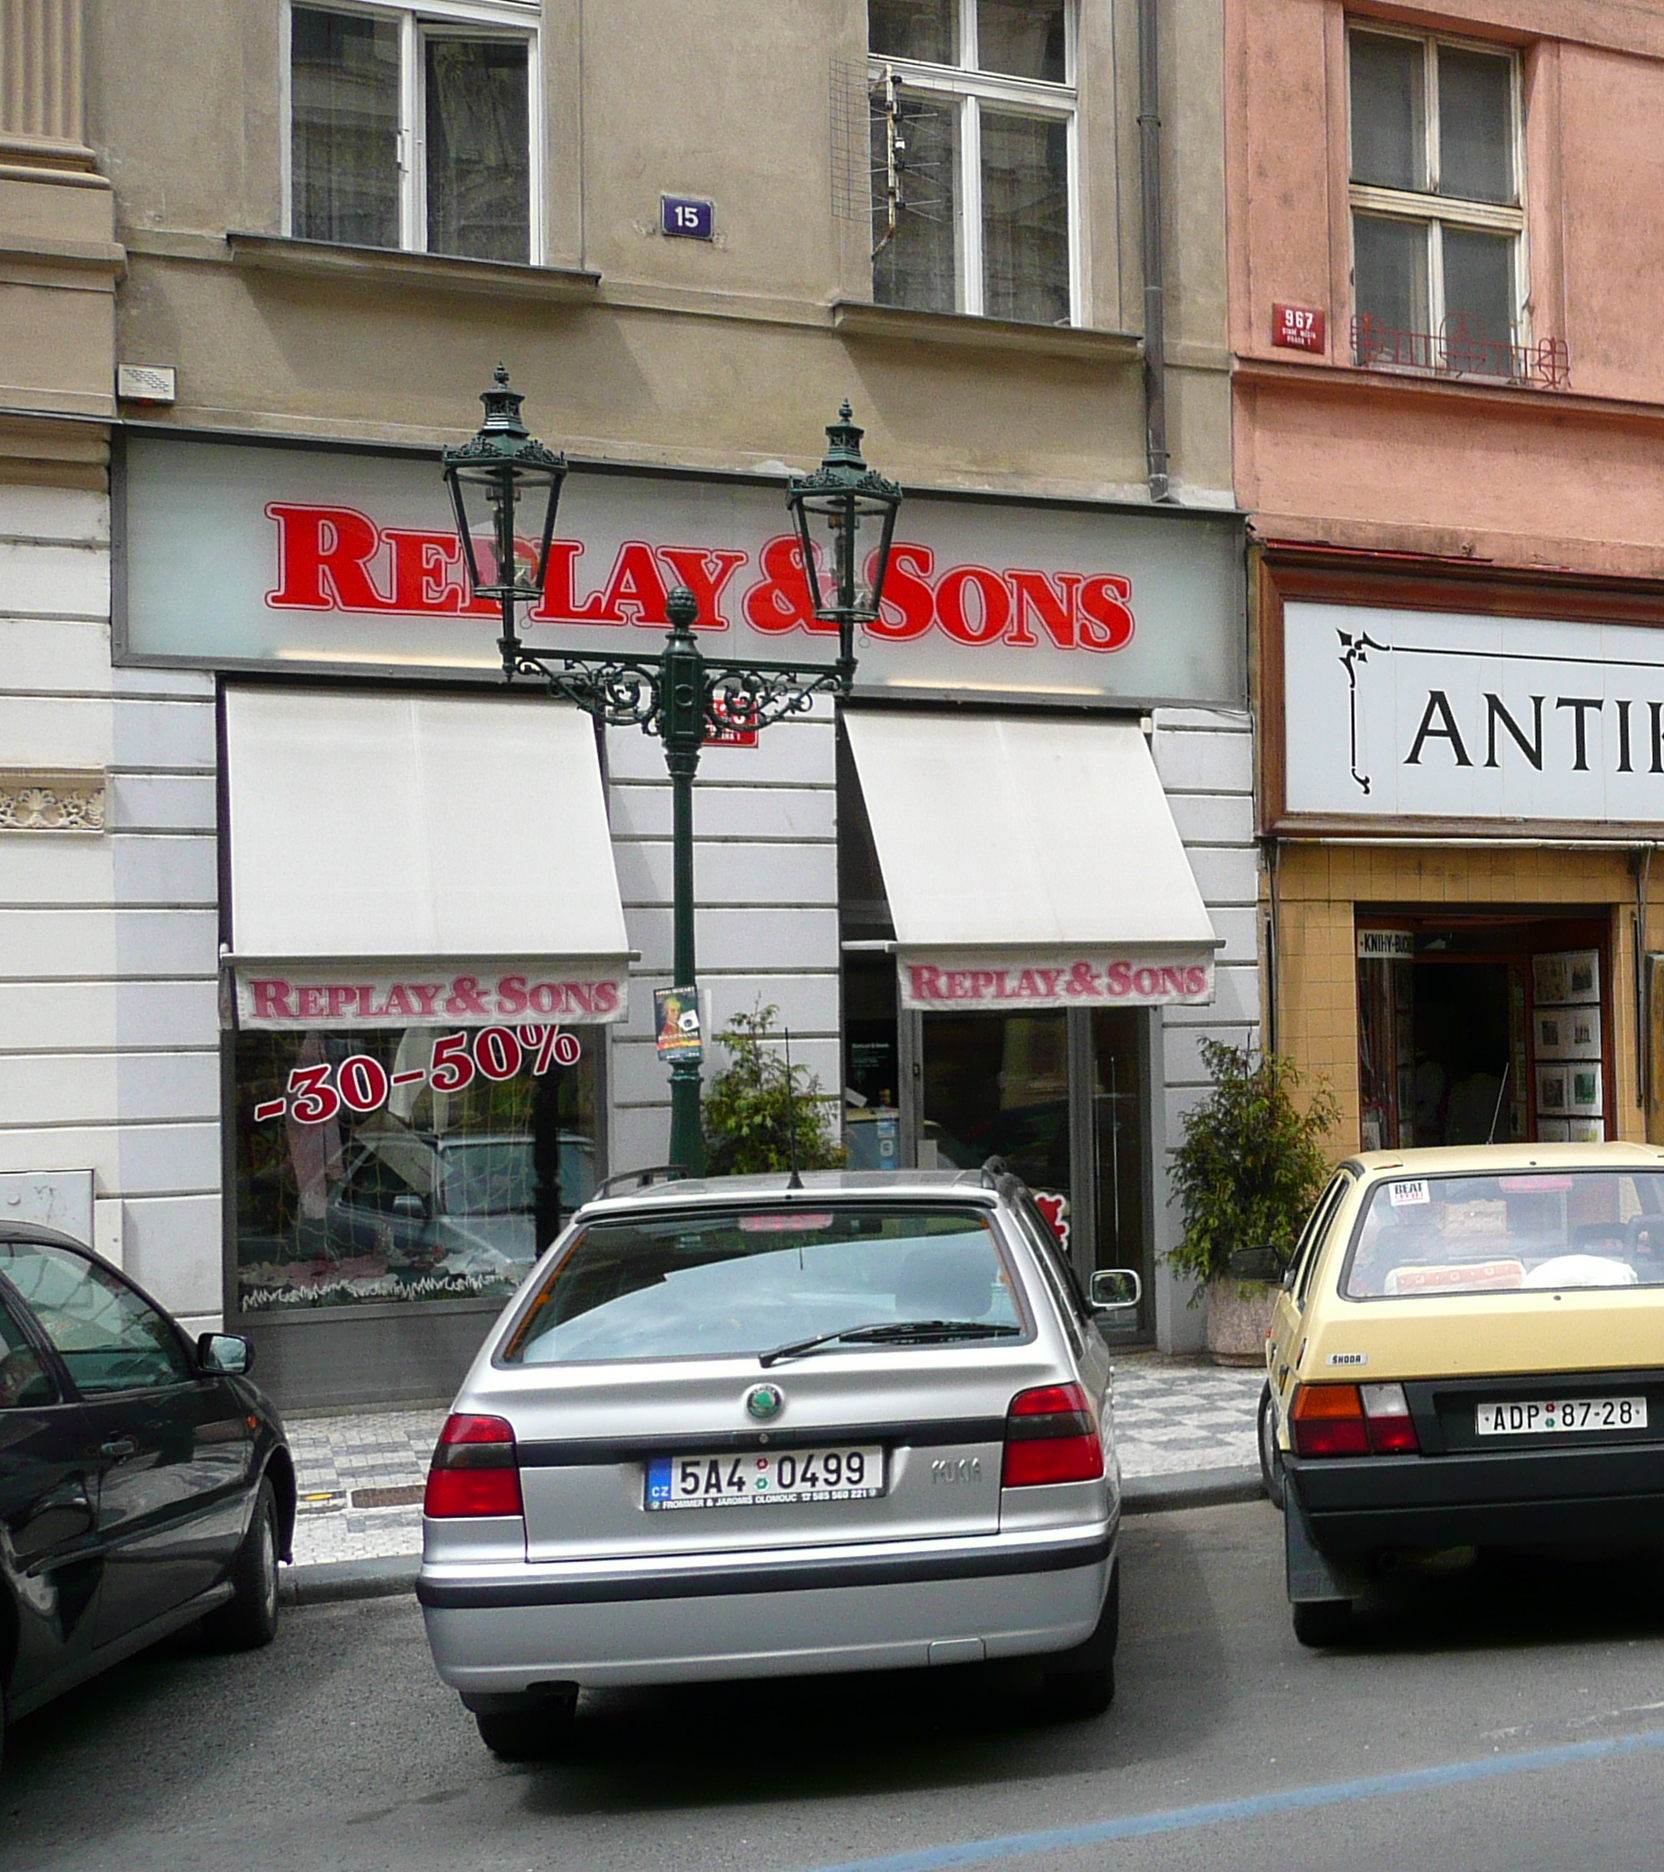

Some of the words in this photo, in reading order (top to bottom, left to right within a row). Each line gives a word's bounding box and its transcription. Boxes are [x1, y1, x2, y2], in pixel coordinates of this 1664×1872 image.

[674, 206, 699, 228] 15
[1285, 309, 1313, 329] 967
[862, 542, 1135, 653] SONS
[907, 963, 1066, 1000] REPLAY
[1066, 960, 1102, 997] &
[1107, 960, 1208, 997] SONS
[248, 980, 444, 1020] REPLAY
[445, 975, 490, 1017] &
[497, 974, 620, 1016] SONS
[1395, 1182, 1423, 1194] BEAT
[1494, 1405, 1539, 1430] ADP
[1561, 1401, 1632, 1427] 87-28
[651, 1487, 669, 1498] CZ
[680, 1458, 746, 1495] 5A4
[777, 1452, 865, 1489] 0499
[755, 1493, 797, 1504] OLOMOUC
